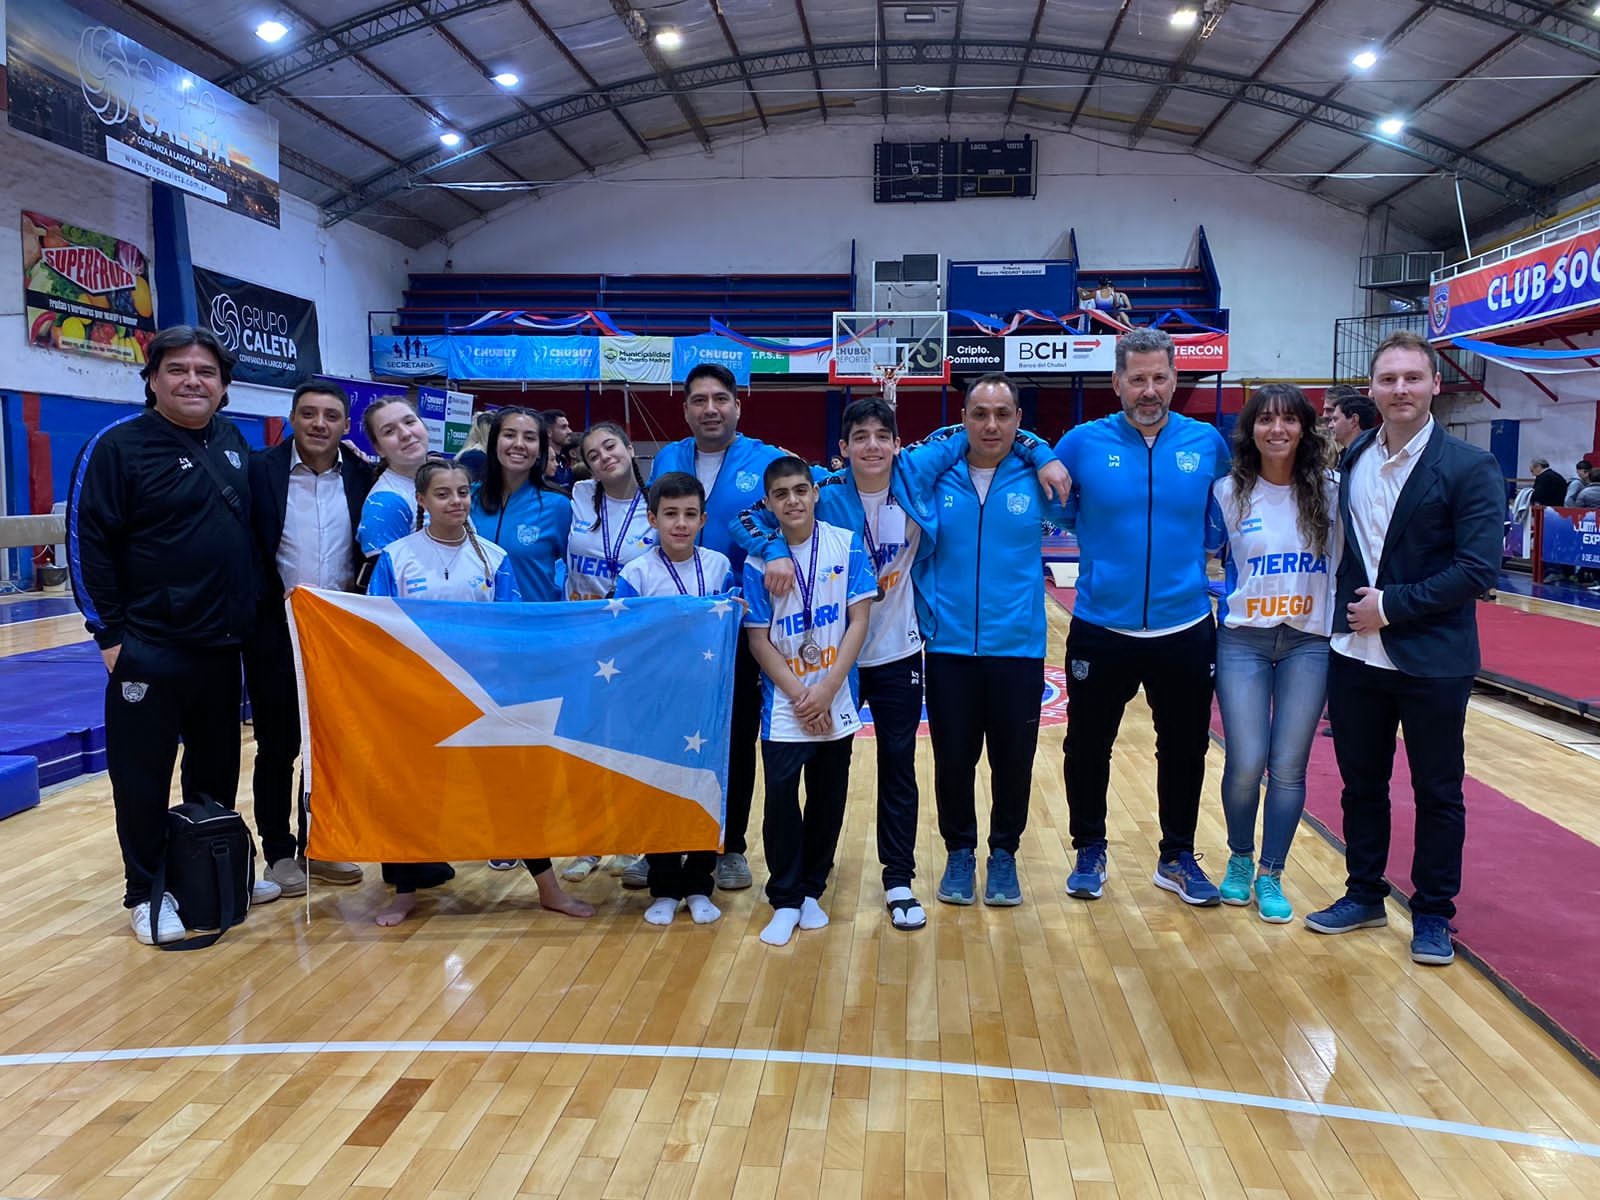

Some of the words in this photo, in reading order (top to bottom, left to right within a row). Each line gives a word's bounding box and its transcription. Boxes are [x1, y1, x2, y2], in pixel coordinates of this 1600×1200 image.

[172, 154, 190, 166] LARGO
[191, 160, 207, 172] PLAZO
[44, 248, 134, 291] SUPERFRUTA
[1487, 263, 1547, 312] CLUB
[241, 305, 288, 335] GRUPO
[242, 328, 297, 359] CALETA
[474, 347, 517, 358] CHUBUT
[549, 347, 593, 358] CHUBUT
[957, 345, 990, 355] Cripto.
[1019, 341, 1068, 360] BCH
[619, 350, 671, 358] Municipalidad
[699, 348, 743, 361] CHUBUT
[946, 355, 1001, 364] Commerce
[570, 552, 625, 578] TIER
[1247, 552, 1327, 577] TIERRA
[1246, 595, 1313, 618] FUEGO
